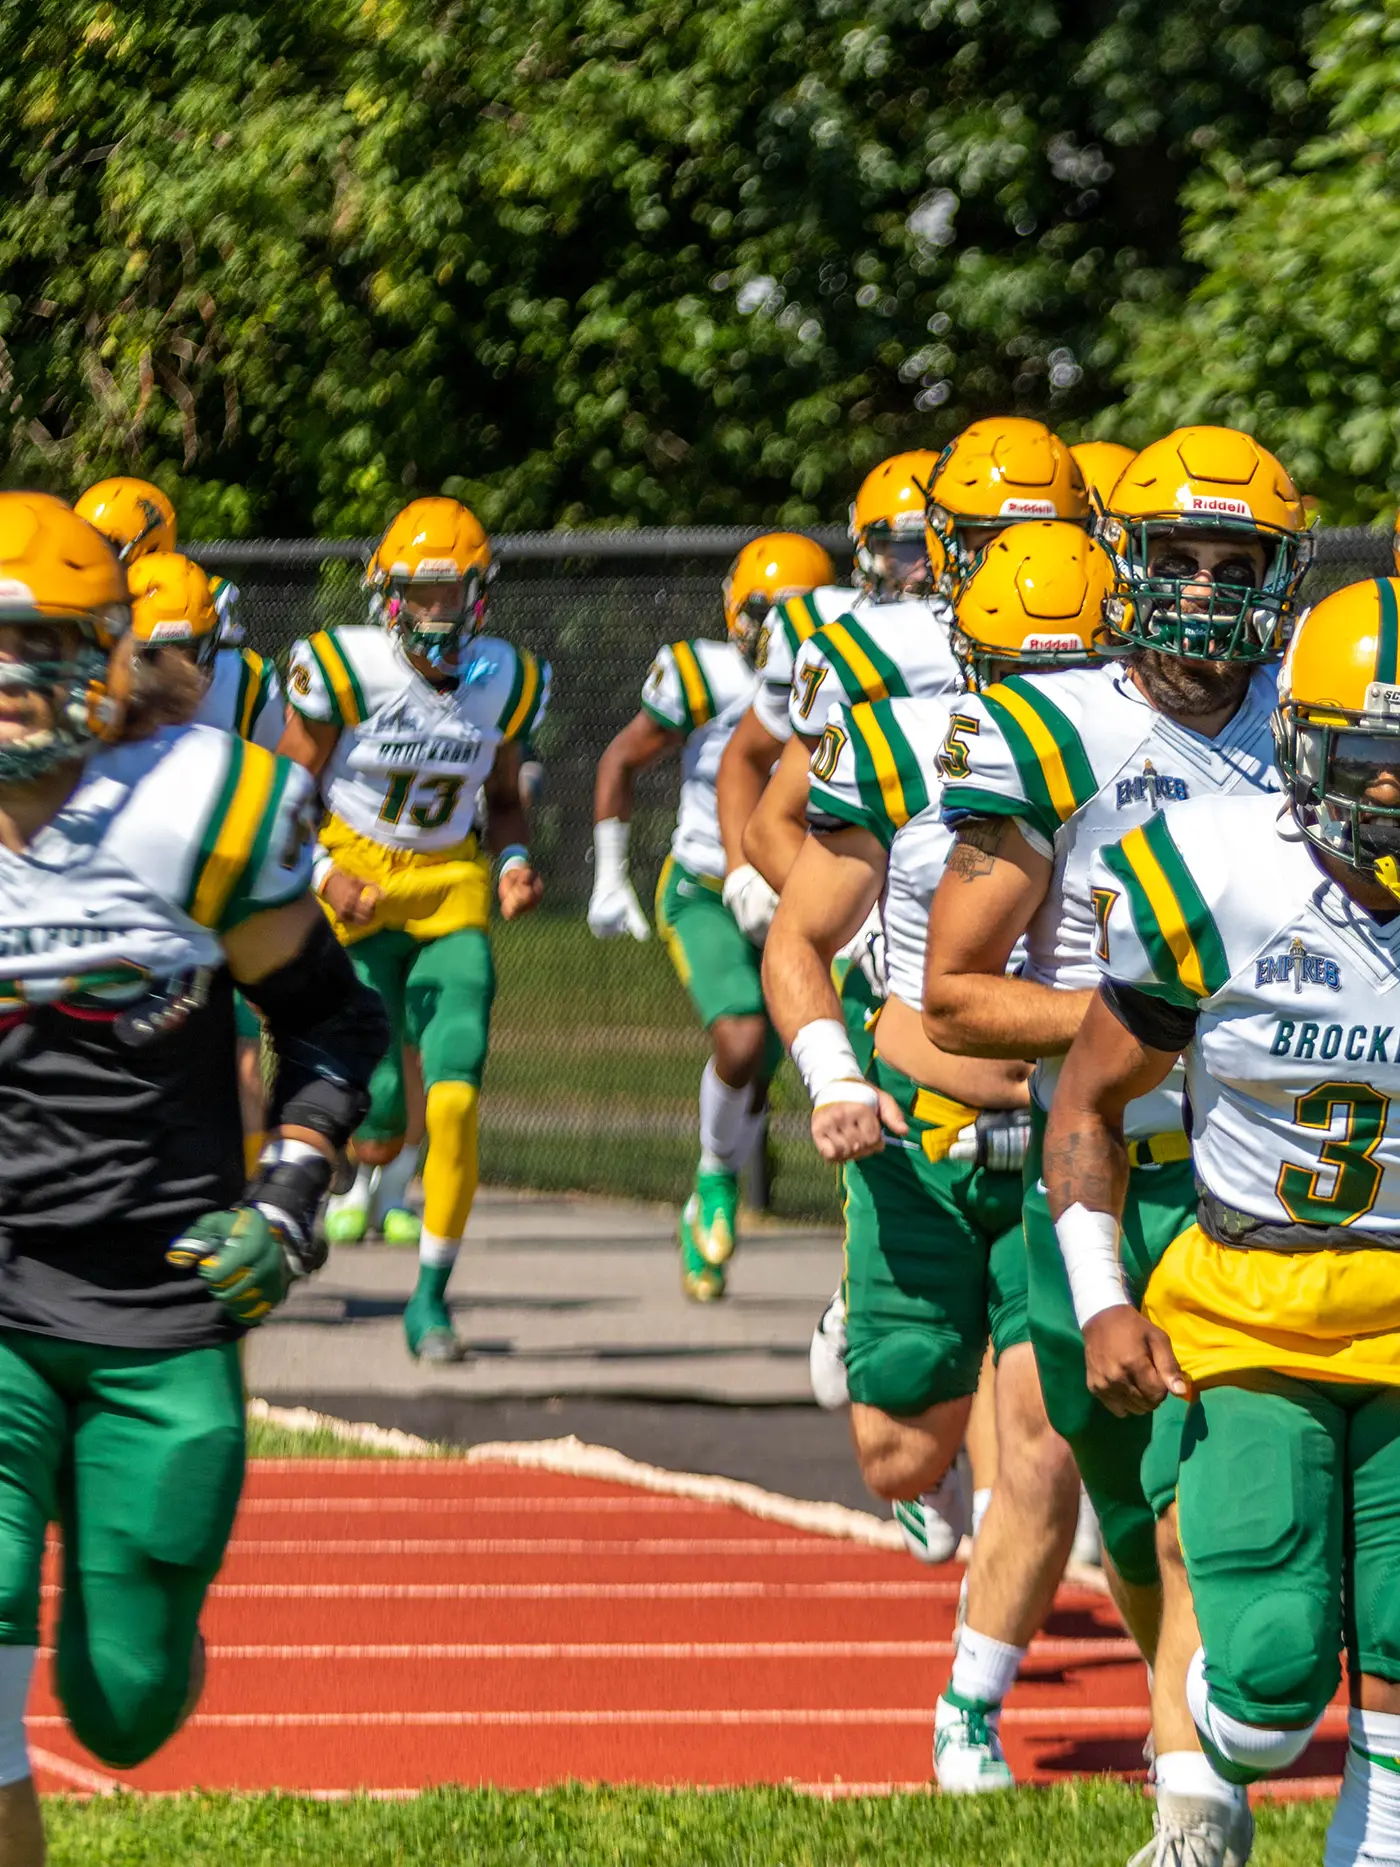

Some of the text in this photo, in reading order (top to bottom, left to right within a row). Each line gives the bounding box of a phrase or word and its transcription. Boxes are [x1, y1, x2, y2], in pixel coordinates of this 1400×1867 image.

[1008, 502, 1053, 514] Riddell
[1193, 498, 1246, 514] Riddell
[1029, 639, 1078, 650] Riddell
[379, 769, 466, 828] 13
